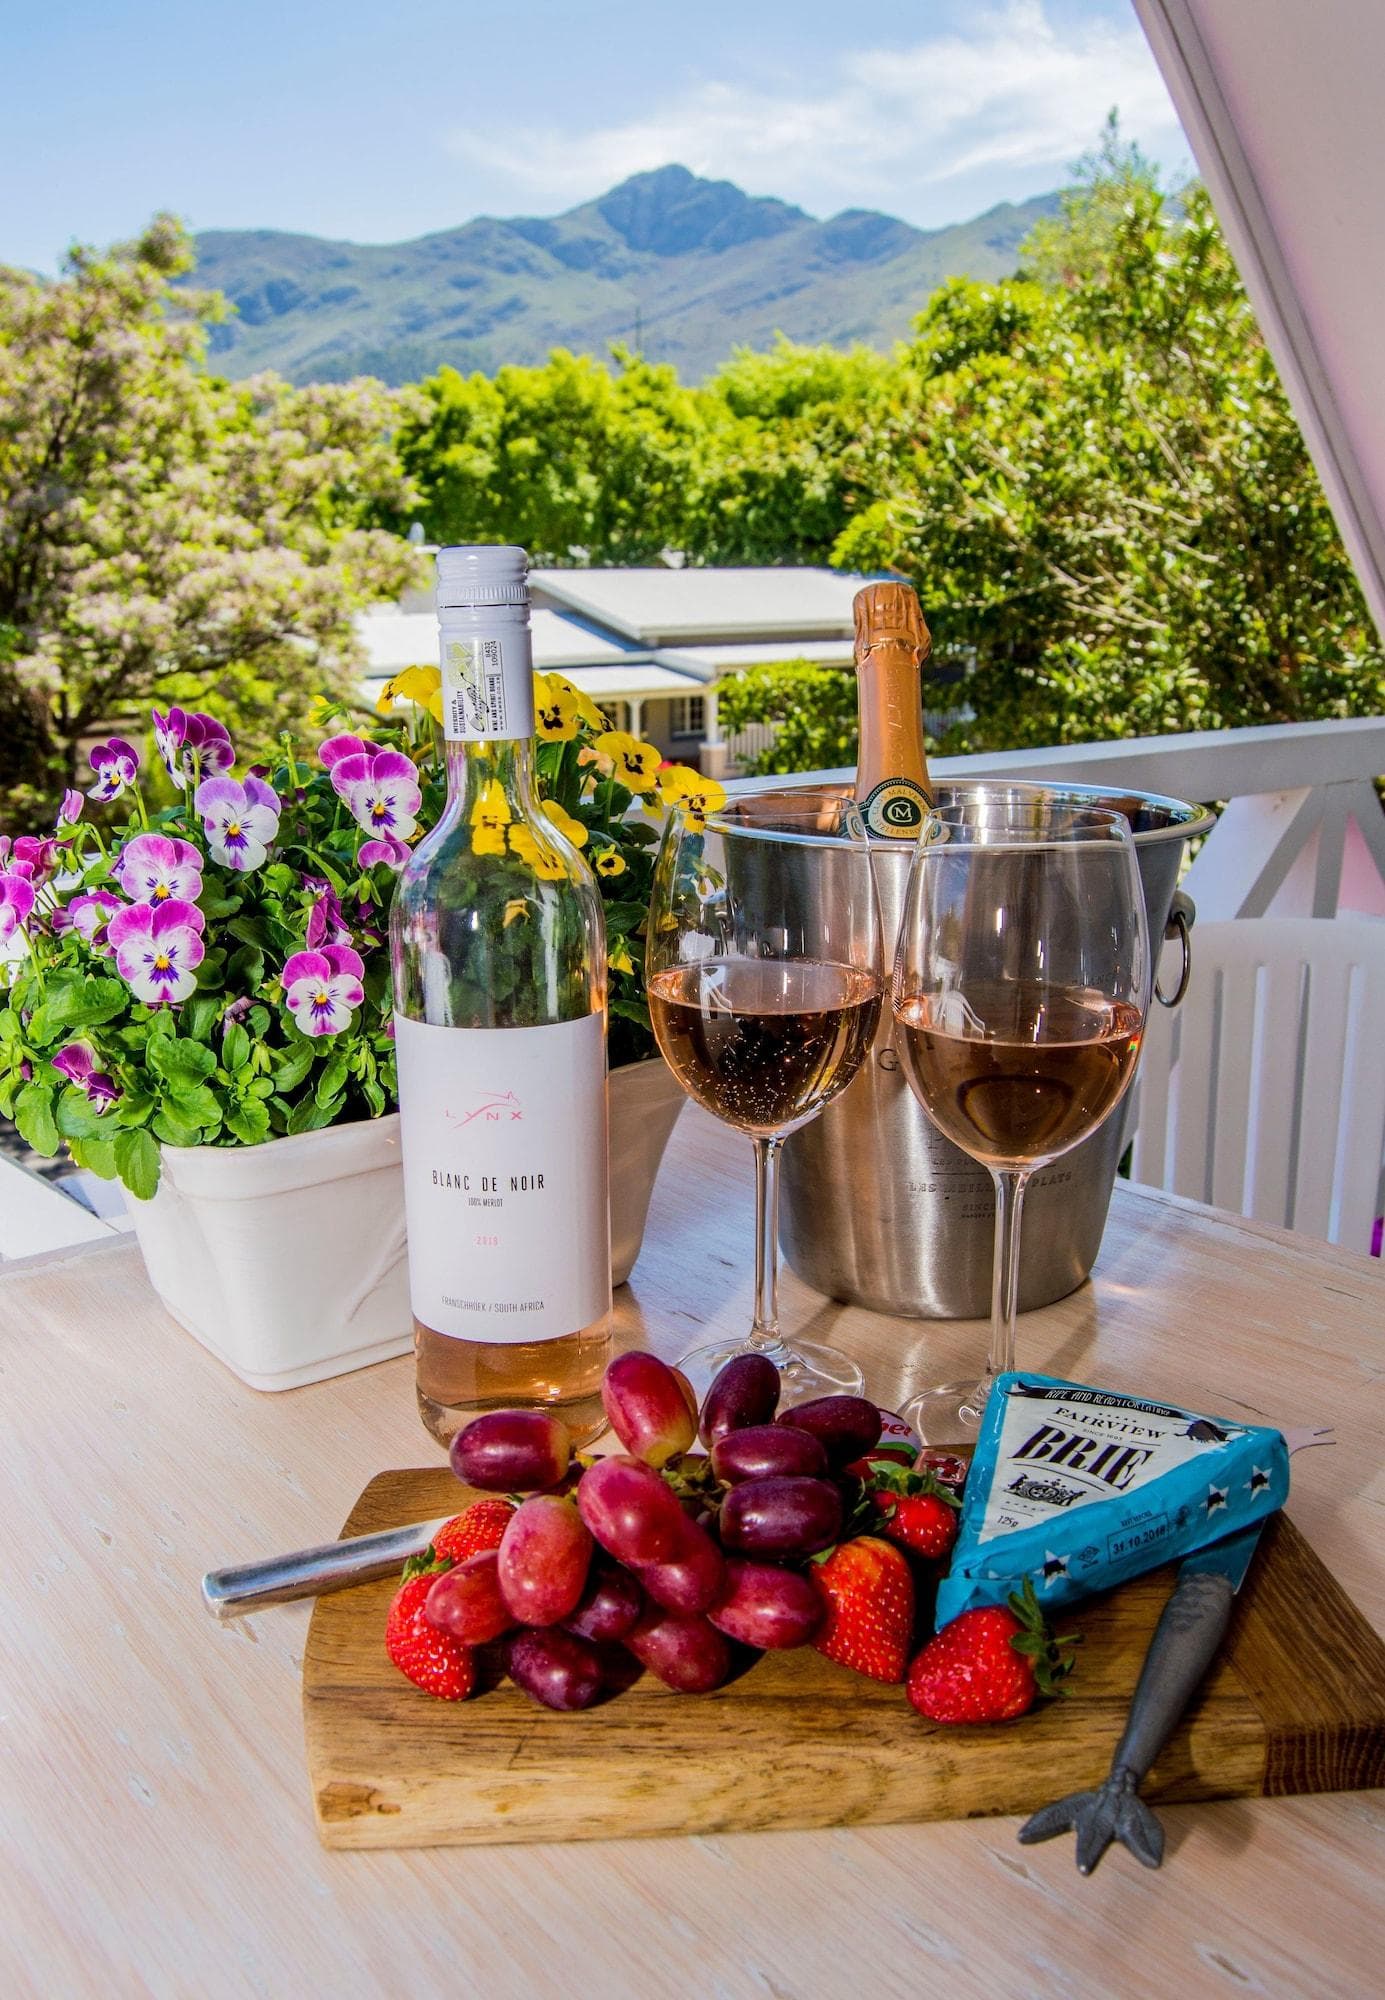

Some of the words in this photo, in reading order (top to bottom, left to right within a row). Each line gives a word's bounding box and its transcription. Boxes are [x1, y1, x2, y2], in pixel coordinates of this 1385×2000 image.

[457, 690, 466, 734] SUSTAINABILITY
[444, 1107, 523, 1122] LYNX
[432, 1169, 470, 1191] BLANC
[482, 1177, 497, 1192] DE
[511, 1174, 545, 1192] NOIR
[1031, 1171, 1072, 1188] PLATS
[468, 1198, 481, 1206] 100%
[482, 1198, 503, 1207] MERLOT
[441, 1296, 487, 1312] FRANSCHHOEK
[494, 1303, 518, 1313] SOUTH
[519, 1301, 545, 1312] AFRICA
[1045, 1389, 1071, 1400] RIPE
[1071, 1391, 1092, 1402] AND
[1093, 1394, 1121, 1407] READY
[1052, 1406, 1167, 1439] FAIRVIEW
[1083, 1429, 1104, 1438] SINCE
[1007, 1423, 1154, 1491] BRIE
[997, 1515, 1019, 1528] 125g
